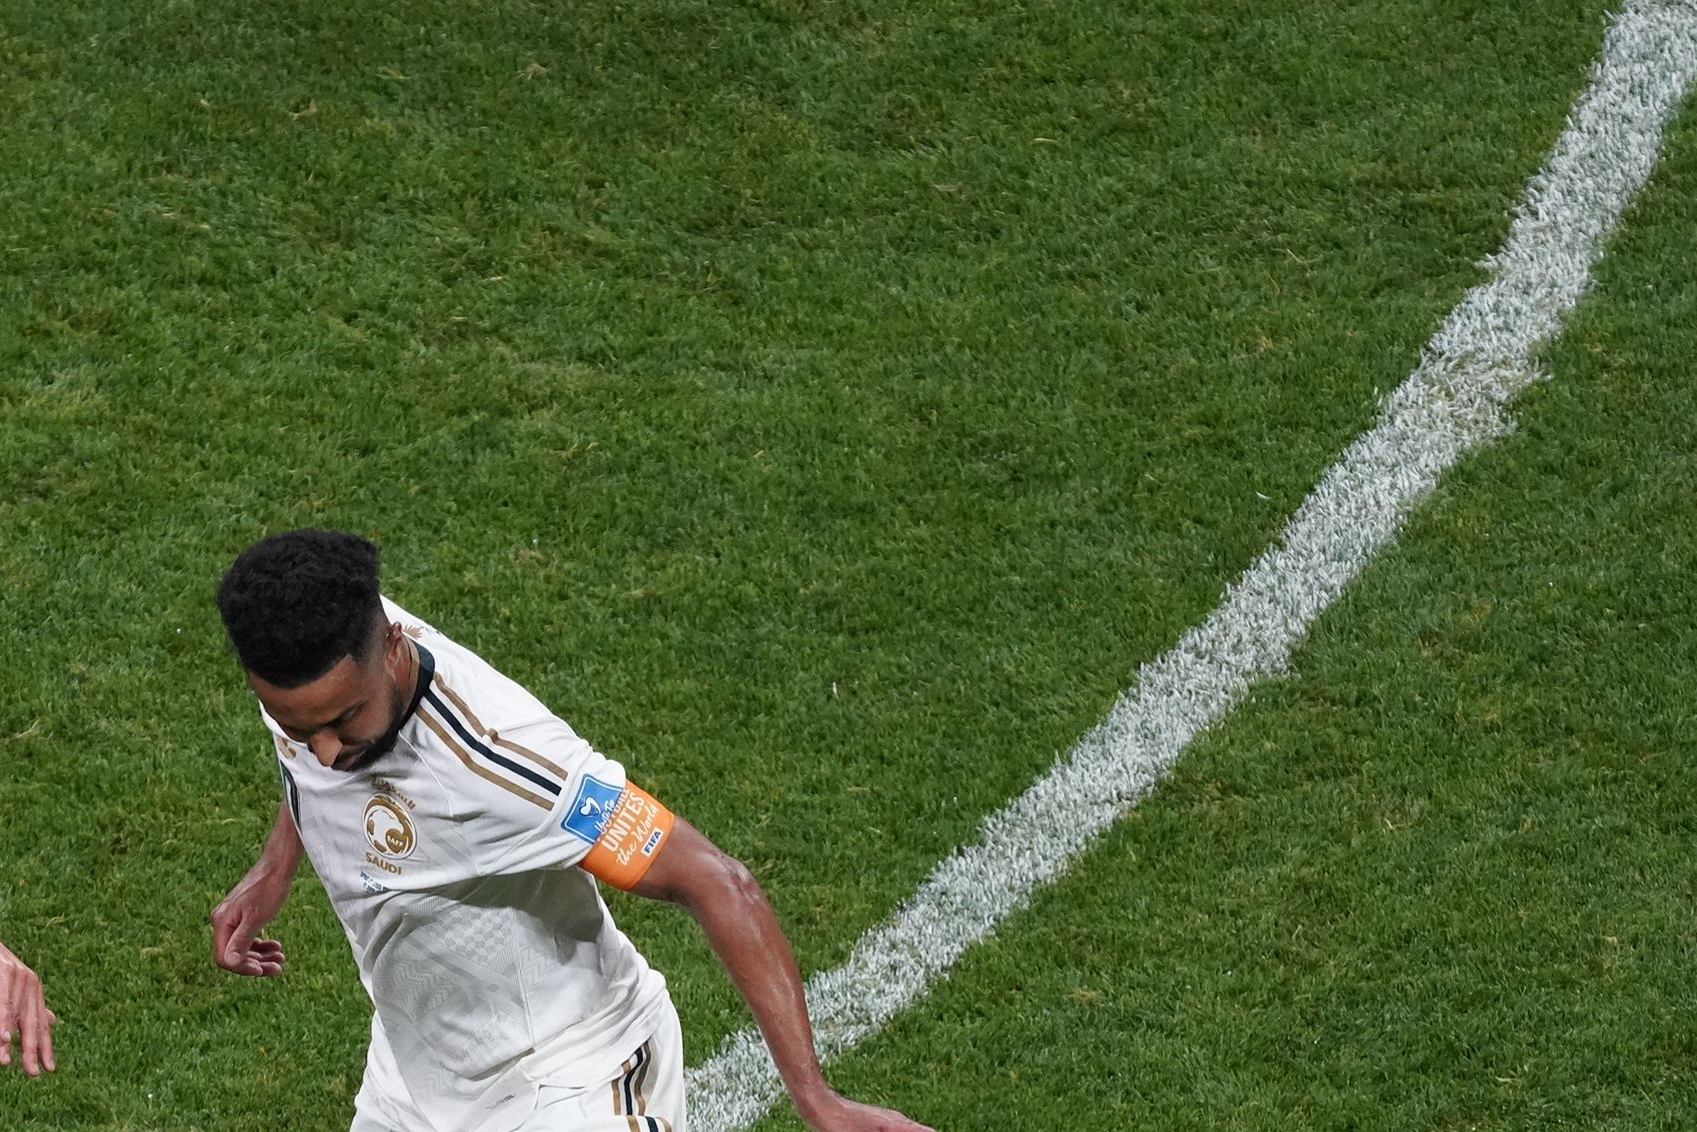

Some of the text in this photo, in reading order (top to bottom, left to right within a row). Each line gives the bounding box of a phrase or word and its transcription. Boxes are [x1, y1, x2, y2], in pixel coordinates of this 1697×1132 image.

[601, 792, 645, 852] UNITES
[616, 800, 660, 866] the World
[644, 830, 662, 854] FIFA
[365, 851, 402, 875] SAUDI
